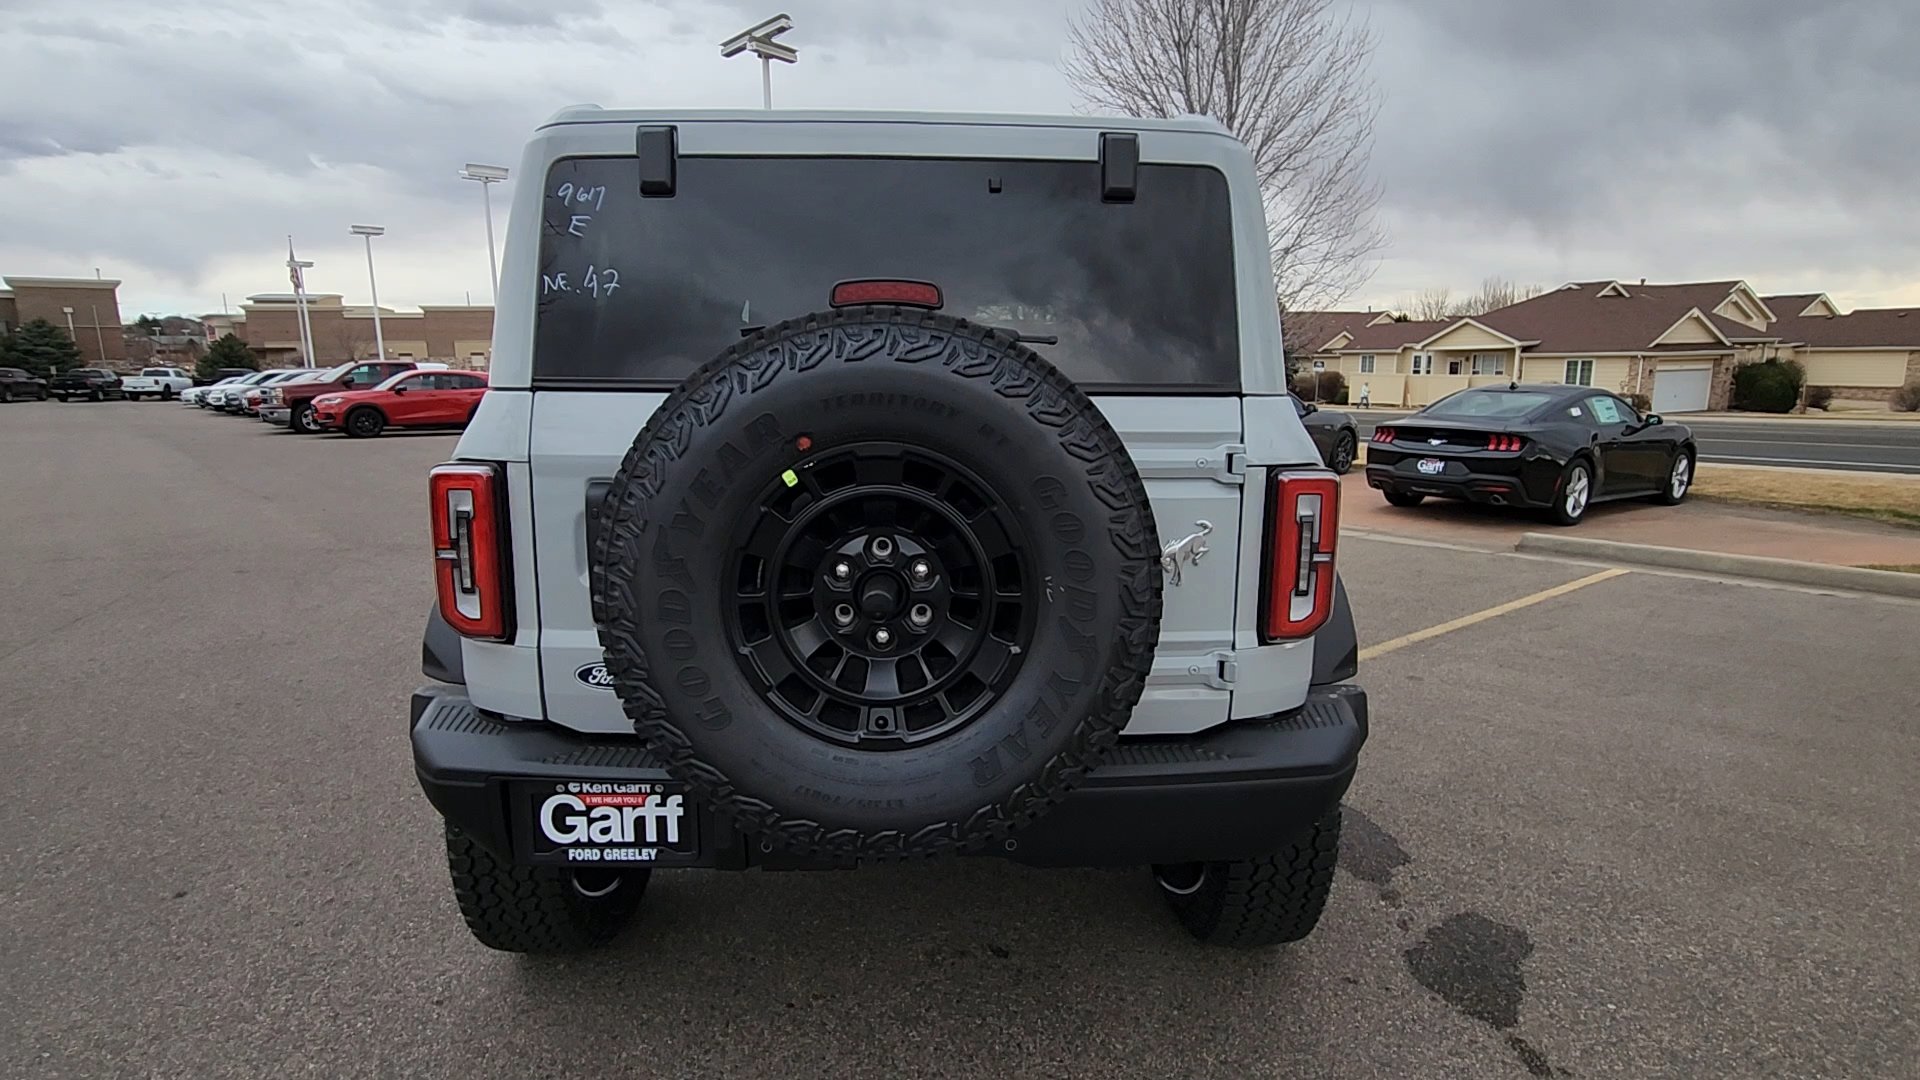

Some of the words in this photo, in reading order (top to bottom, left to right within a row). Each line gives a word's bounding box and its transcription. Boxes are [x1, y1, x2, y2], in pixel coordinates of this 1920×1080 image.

[557, 182, 606, 211] 9617
[568, 215, 592, 238] E
[582, 782, 612, 794] Ken
[602, 796, 621, 804] HEAR
[621, 796, 639, 804] YOU
[540, 793, 684, 845] Garff
[568, 848, 601, 861] FORD
[602, 848, 658, 861] GREELEY
